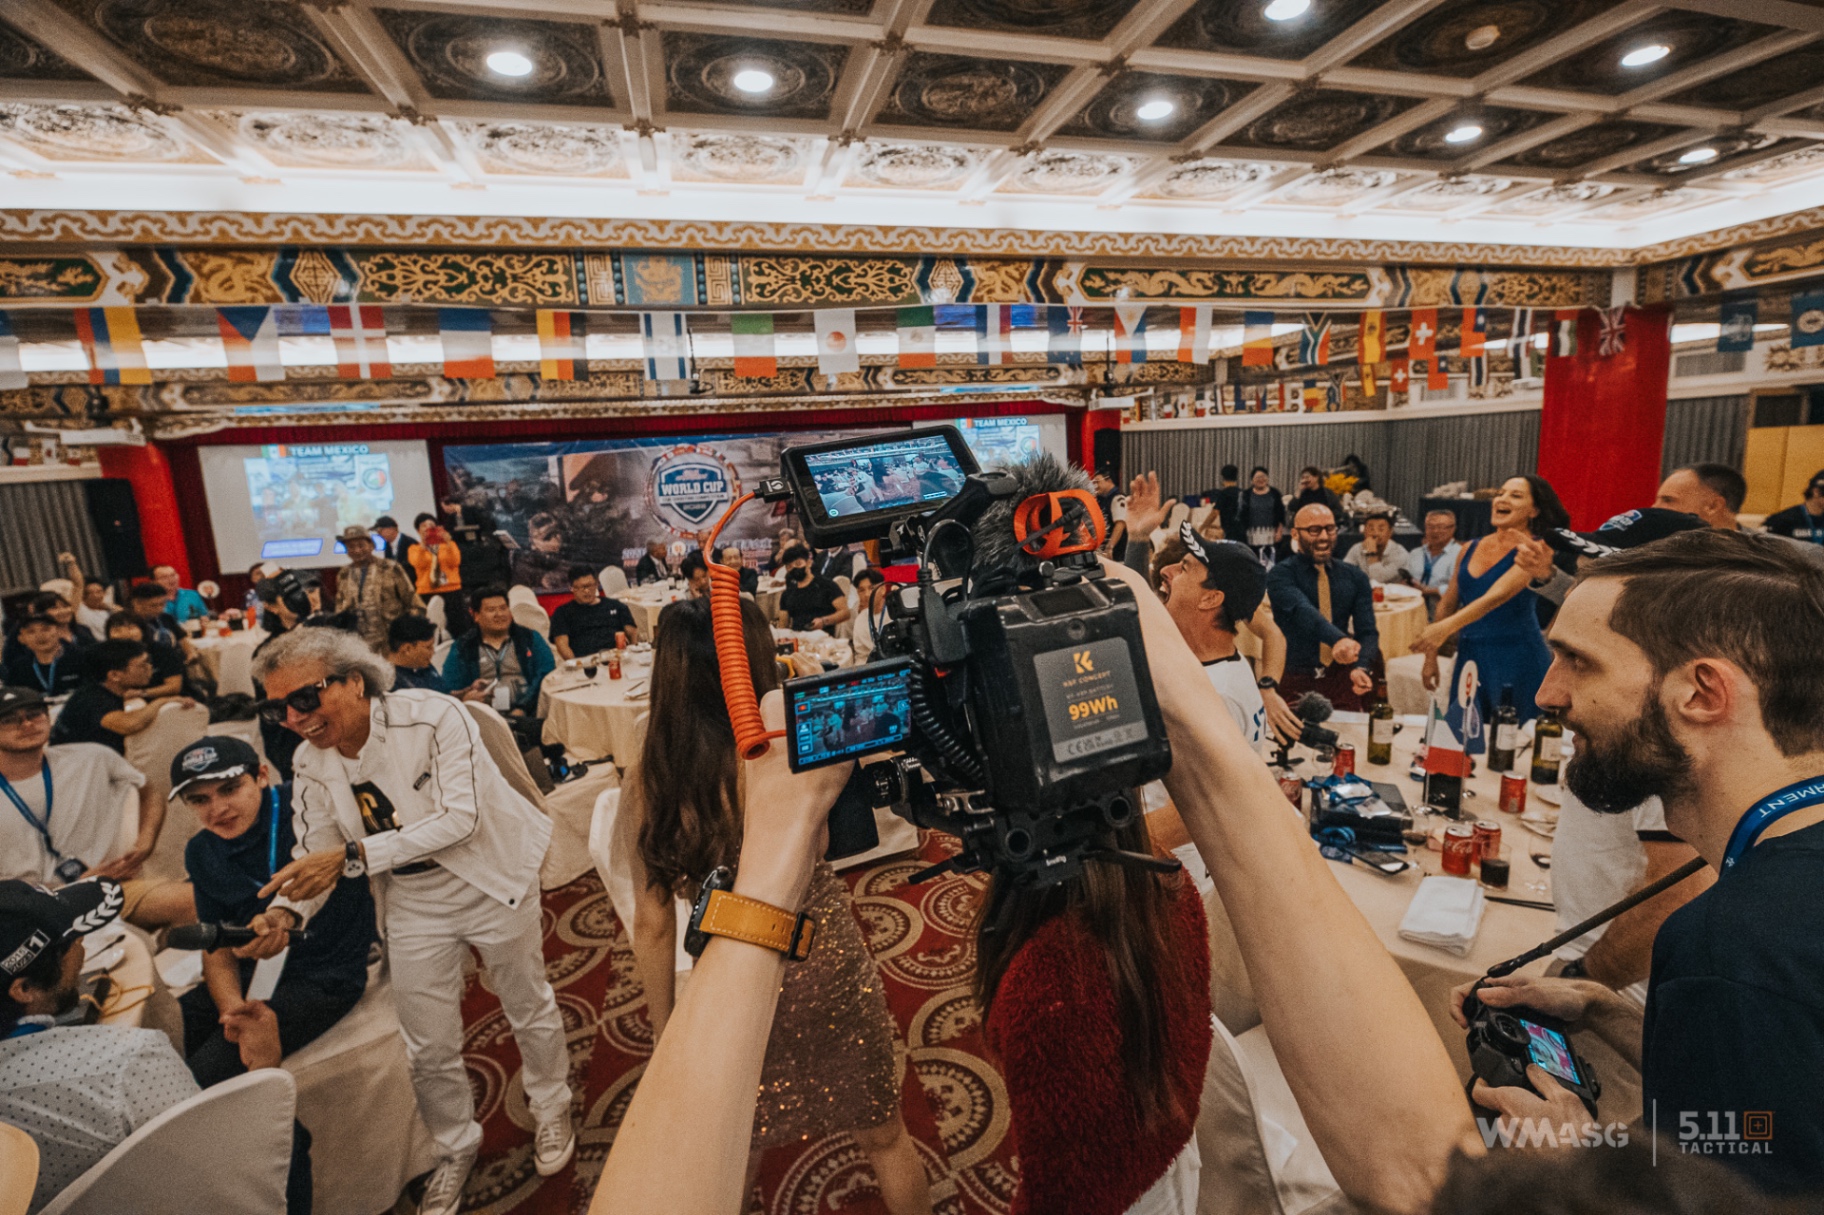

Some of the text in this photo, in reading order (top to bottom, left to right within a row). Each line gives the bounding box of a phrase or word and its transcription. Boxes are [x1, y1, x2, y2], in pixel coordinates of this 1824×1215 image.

[974, 417, 1028, 428] TEAM MEXICO
[288, 443, 369, 457] TEAM MEXICO
[661, 480, 725, 496] WORLD CUP
[1068, 694, 1119, 721] 99Wh
[29, 935, 45, 949] 1
